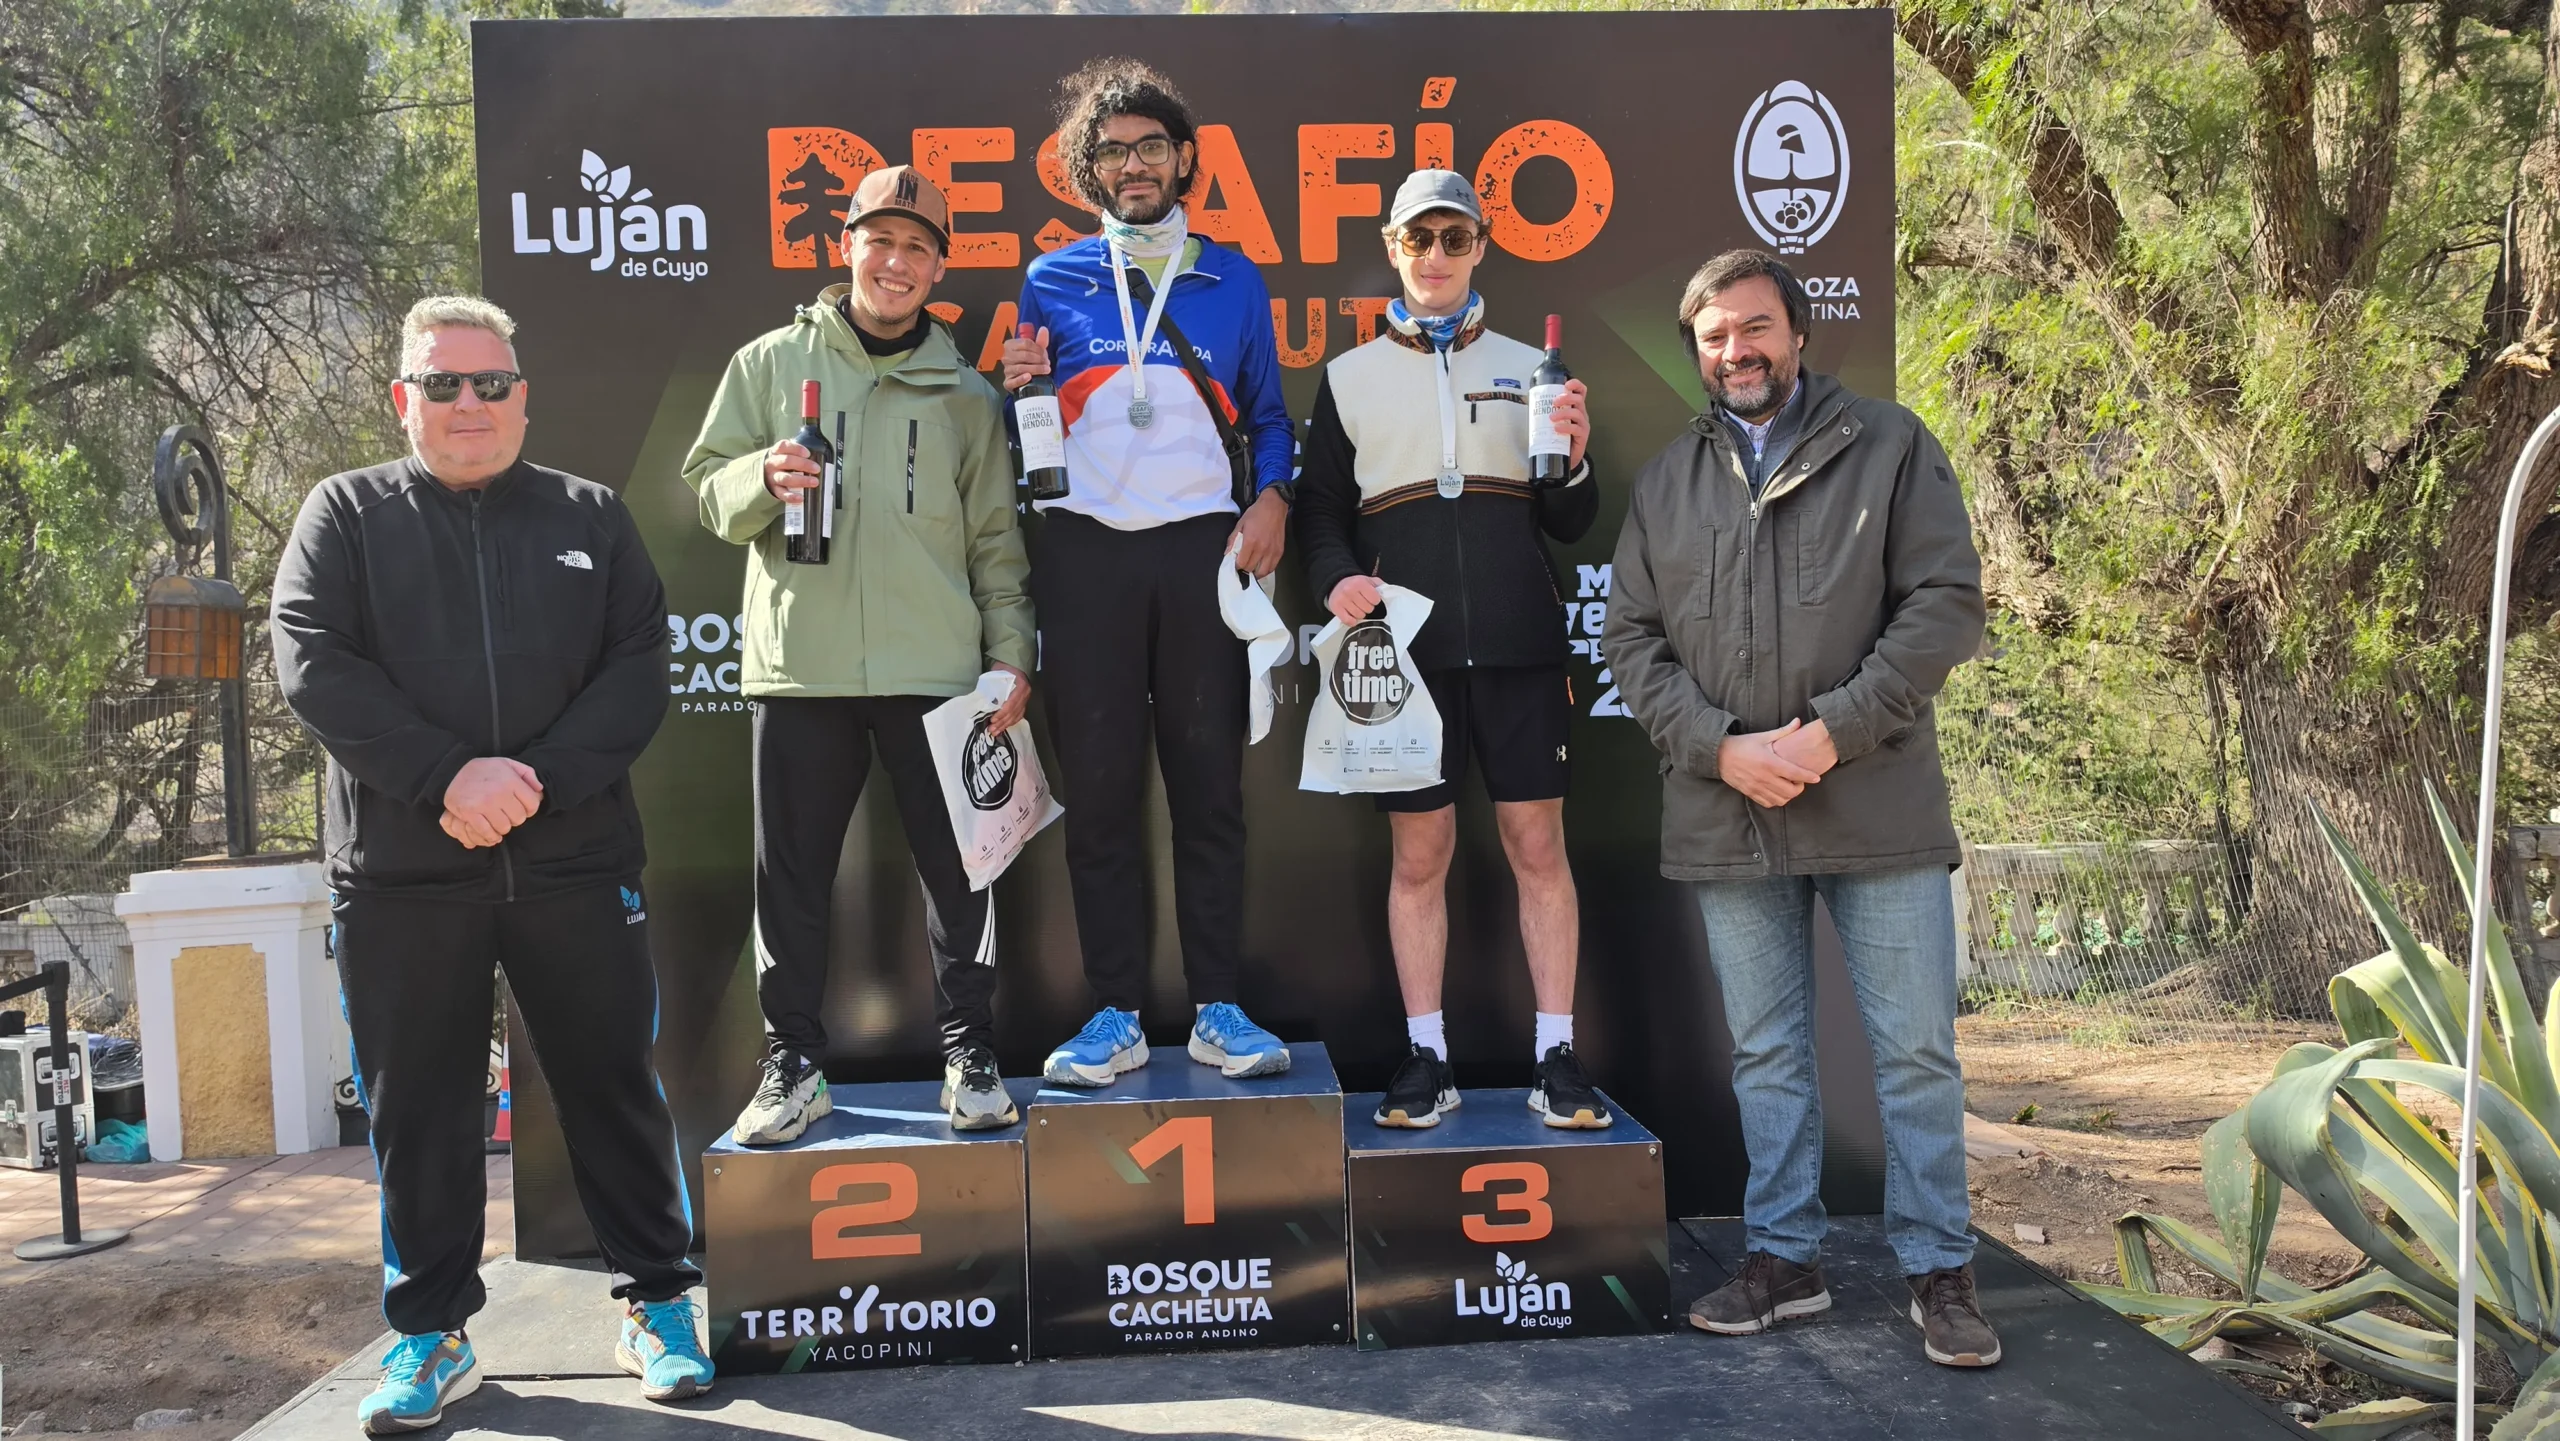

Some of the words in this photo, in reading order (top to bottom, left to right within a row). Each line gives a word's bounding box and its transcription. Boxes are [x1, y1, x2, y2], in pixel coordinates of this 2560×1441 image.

[511, 187, 708, 272] Luján
[620, 257, 648, 277] de
[652, 257, 709, 282] Cuyo
[1021, 418, 1055, 431] MENDOZA
[1022, 411, 1052, 422] ESTANCIA
[1347, 641, 1395, 671] free
[1342, 669, 1403, 703] time
[1129, 1117, 1214, 1225] 1
[809, 1161, 922, 1259] 2
[1460, 1161, 1554, 1243] 3
[1107, 1257, 1273, 1298] BOSQUE
[1108, 1296, 1273, 1327] CACHEUTA
[1455, 1273, 1571, 1325] Luján
[1125, 1330, 1194, 1342] PARADOR
[1201, 1328, 1258, 1339] ANDINO
[1520, 1315, 1537, 1328] de
[1538, 1314, 1573, 1329] Cuyo
[809, 1340, 933, 1362] YACOPINI
